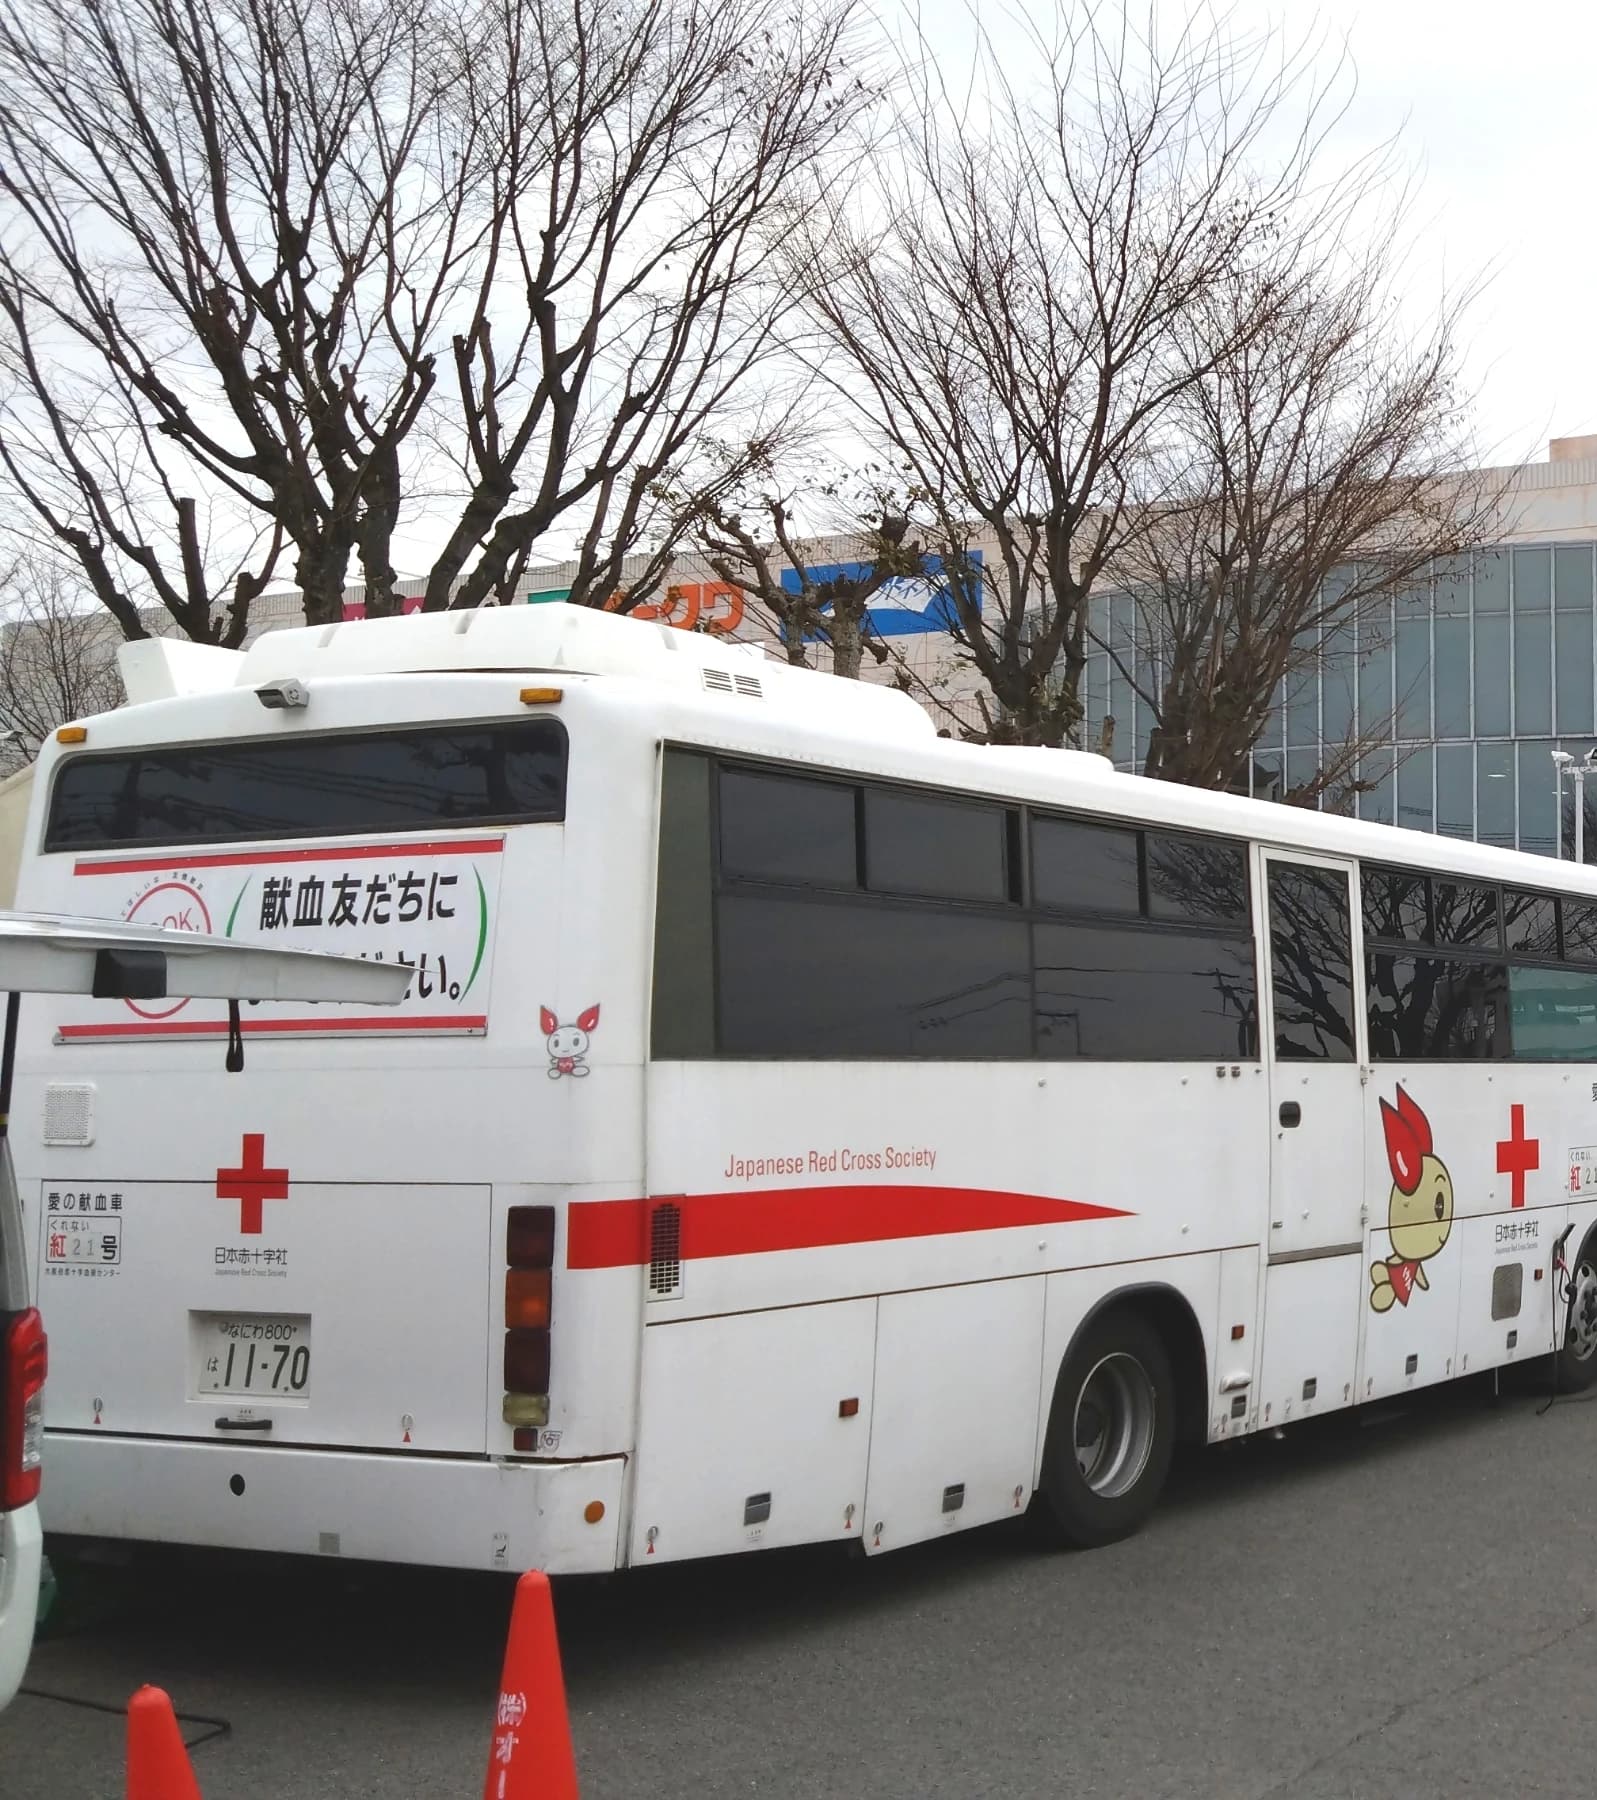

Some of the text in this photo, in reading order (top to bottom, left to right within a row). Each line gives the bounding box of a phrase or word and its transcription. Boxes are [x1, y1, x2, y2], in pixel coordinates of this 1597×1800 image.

[259, 870, 458, 931] 献血友だちに
[724, 1146, 937, 1181] Japanese Red Cross Society
[48, 1192, 123, 1211] 愛の献血車
[50, 1219, 89, 1232] くれない
[1495, 1220, 1539, 1243] 日本赤十字社
[215, 1246, 288, 1265] 日本赤十字社
[207, 1357, 219, 1373] は
